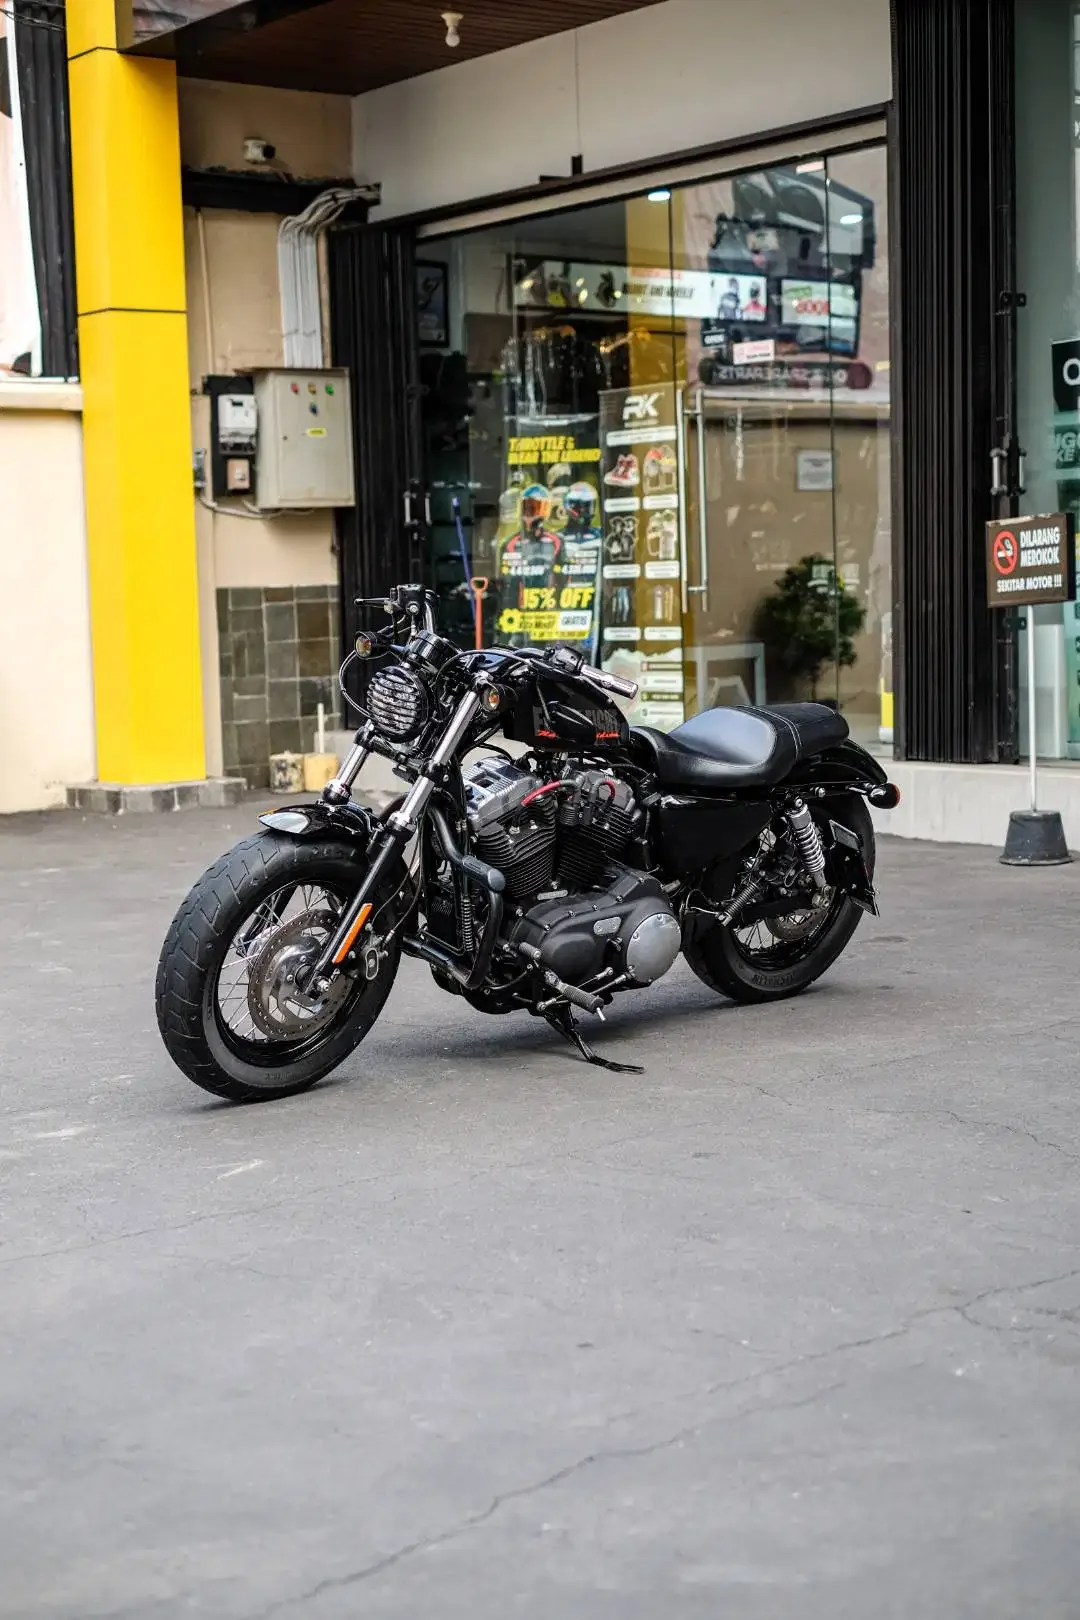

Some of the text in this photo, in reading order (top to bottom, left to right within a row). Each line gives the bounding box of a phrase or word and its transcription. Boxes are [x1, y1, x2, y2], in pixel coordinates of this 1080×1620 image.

[1020, 526, 1061, 549] DILARANG
[1020, 546, 1060, 568] MEROKOK
[996, 577, 1026, 593] SEKITAR
[1026, 574, 1053, 590] MOTOR
[523, 587, 596, 610] 15% OFF
